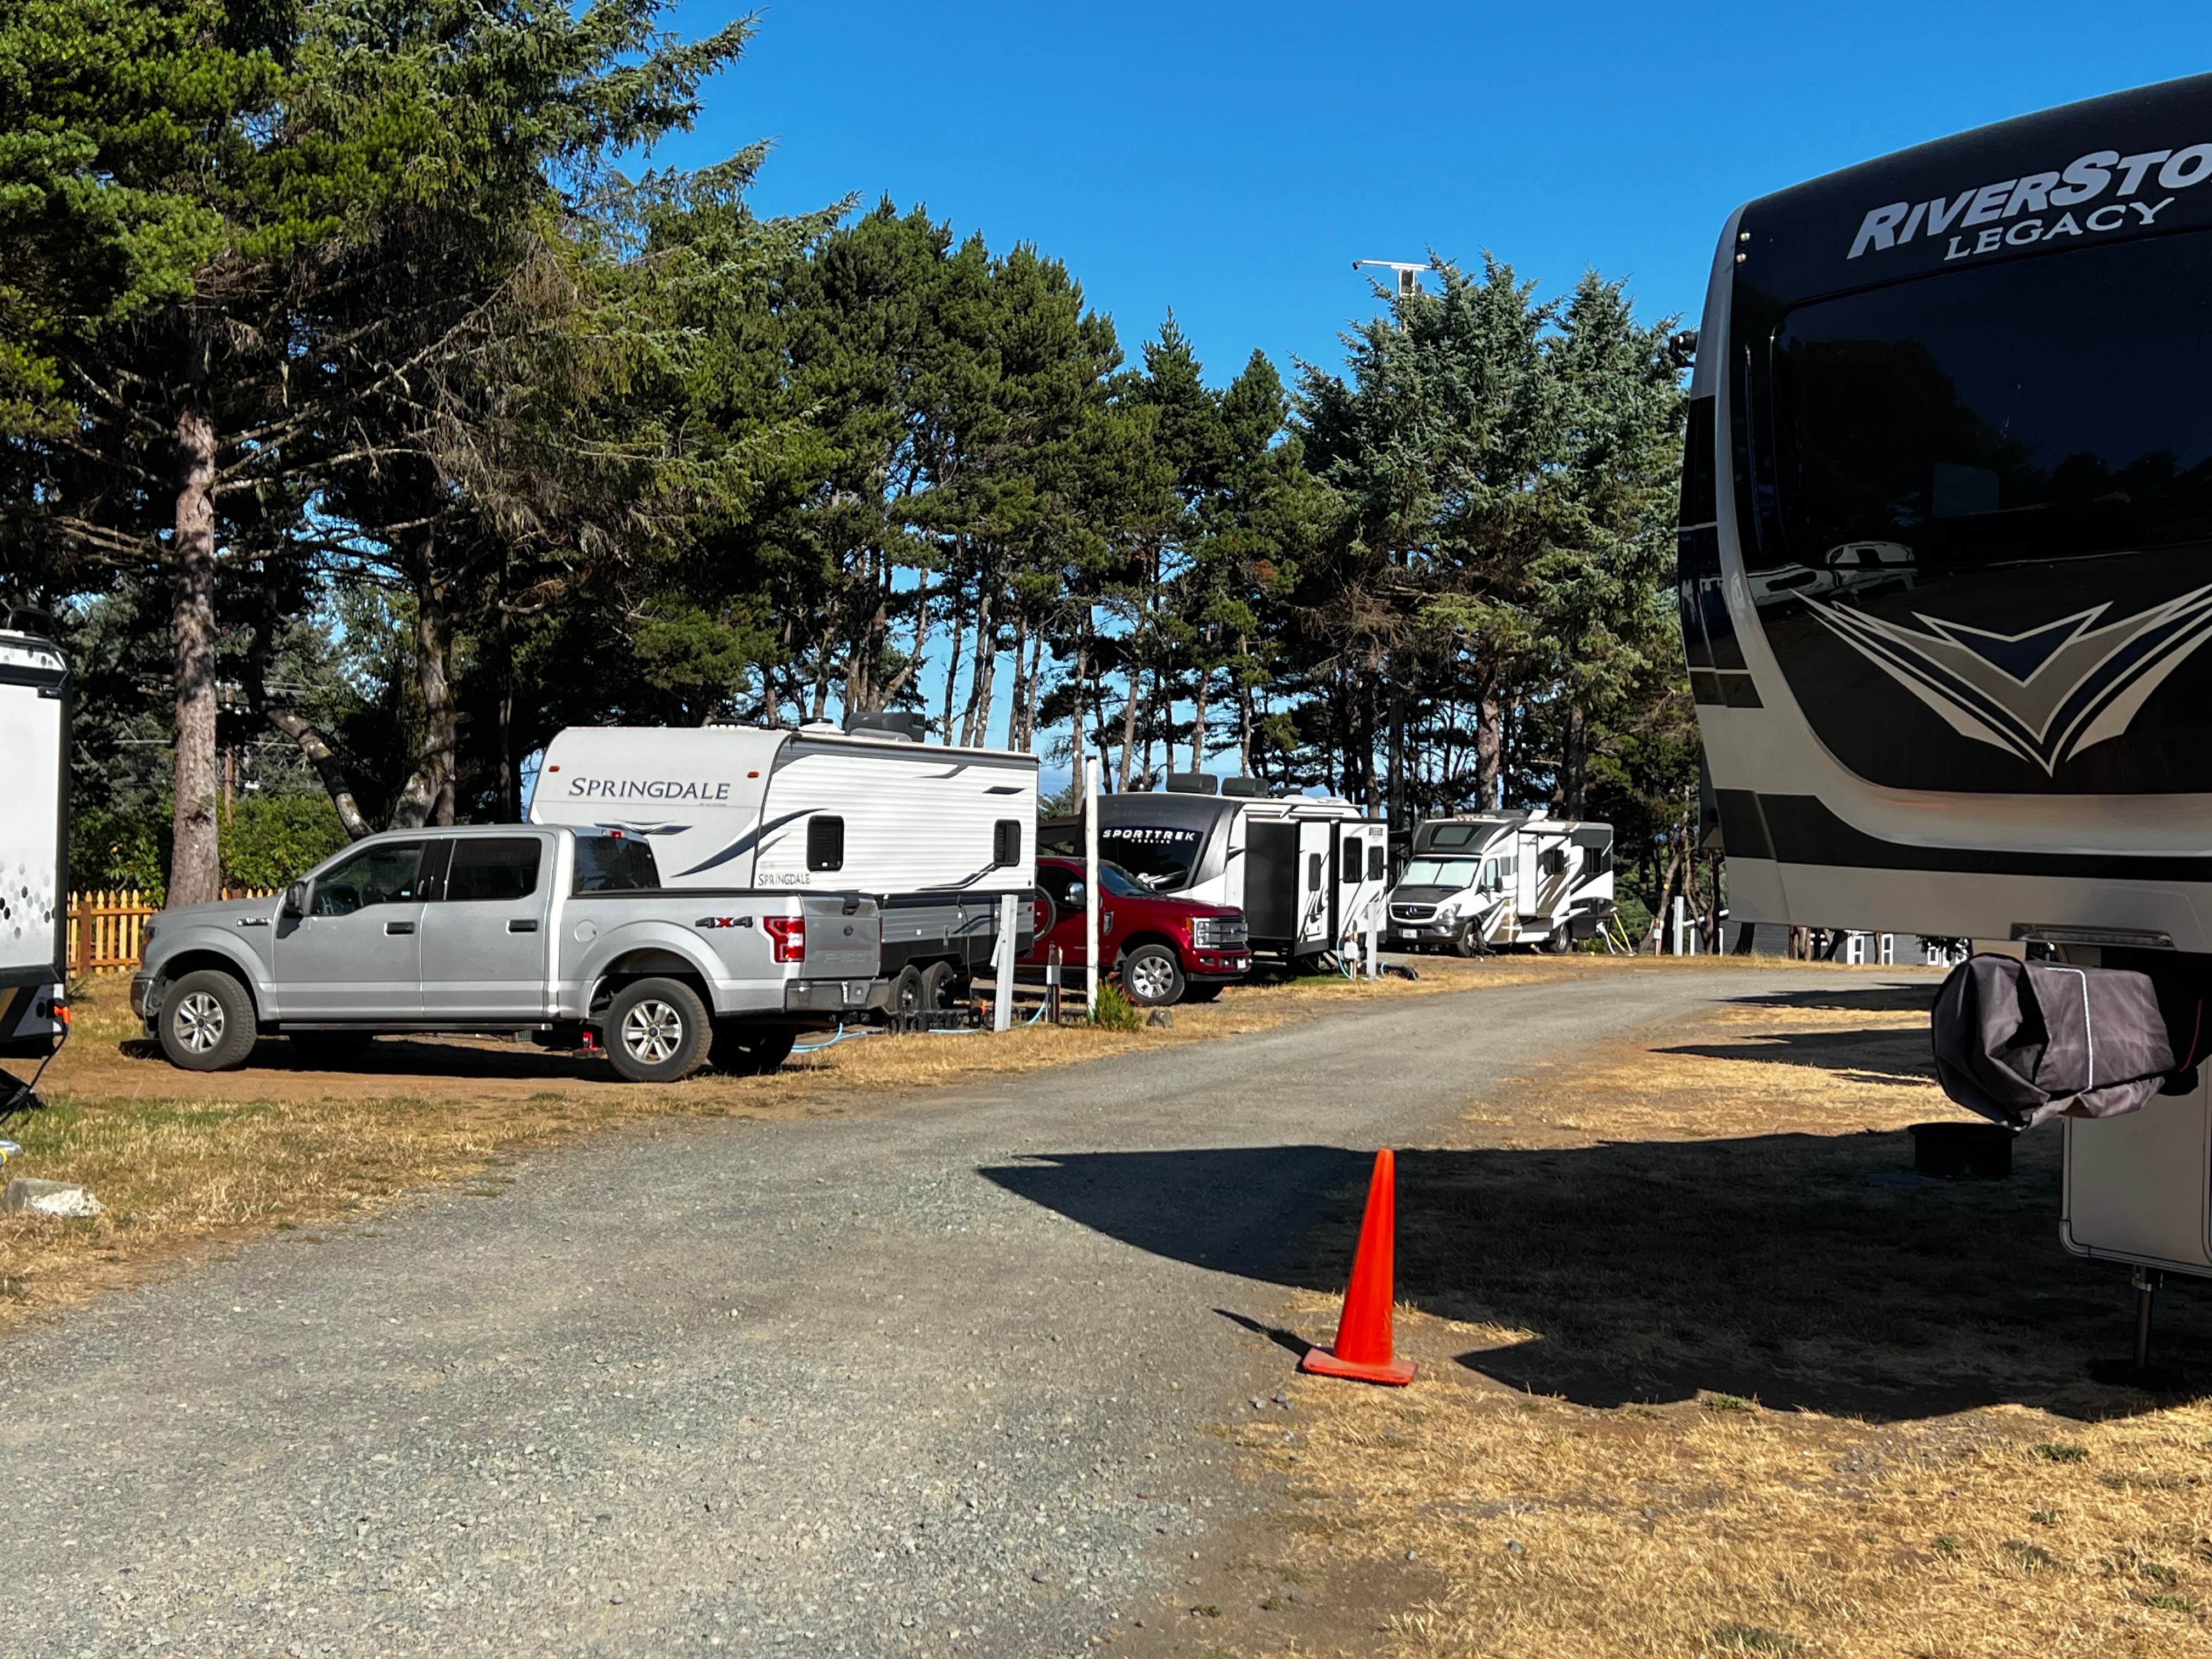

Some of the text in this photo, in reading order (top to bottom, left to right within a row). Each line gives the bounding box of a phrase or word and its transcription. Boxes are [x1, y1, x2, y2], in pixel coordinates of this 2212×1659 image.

[1944, 198, 2175, 261] LEGACY
[568, 777, 730, 800] SPRINGDALE
[1102, 829, 1195, 841] SPORTTREK
[758, 873, 810, 886] SPRINGDALE
